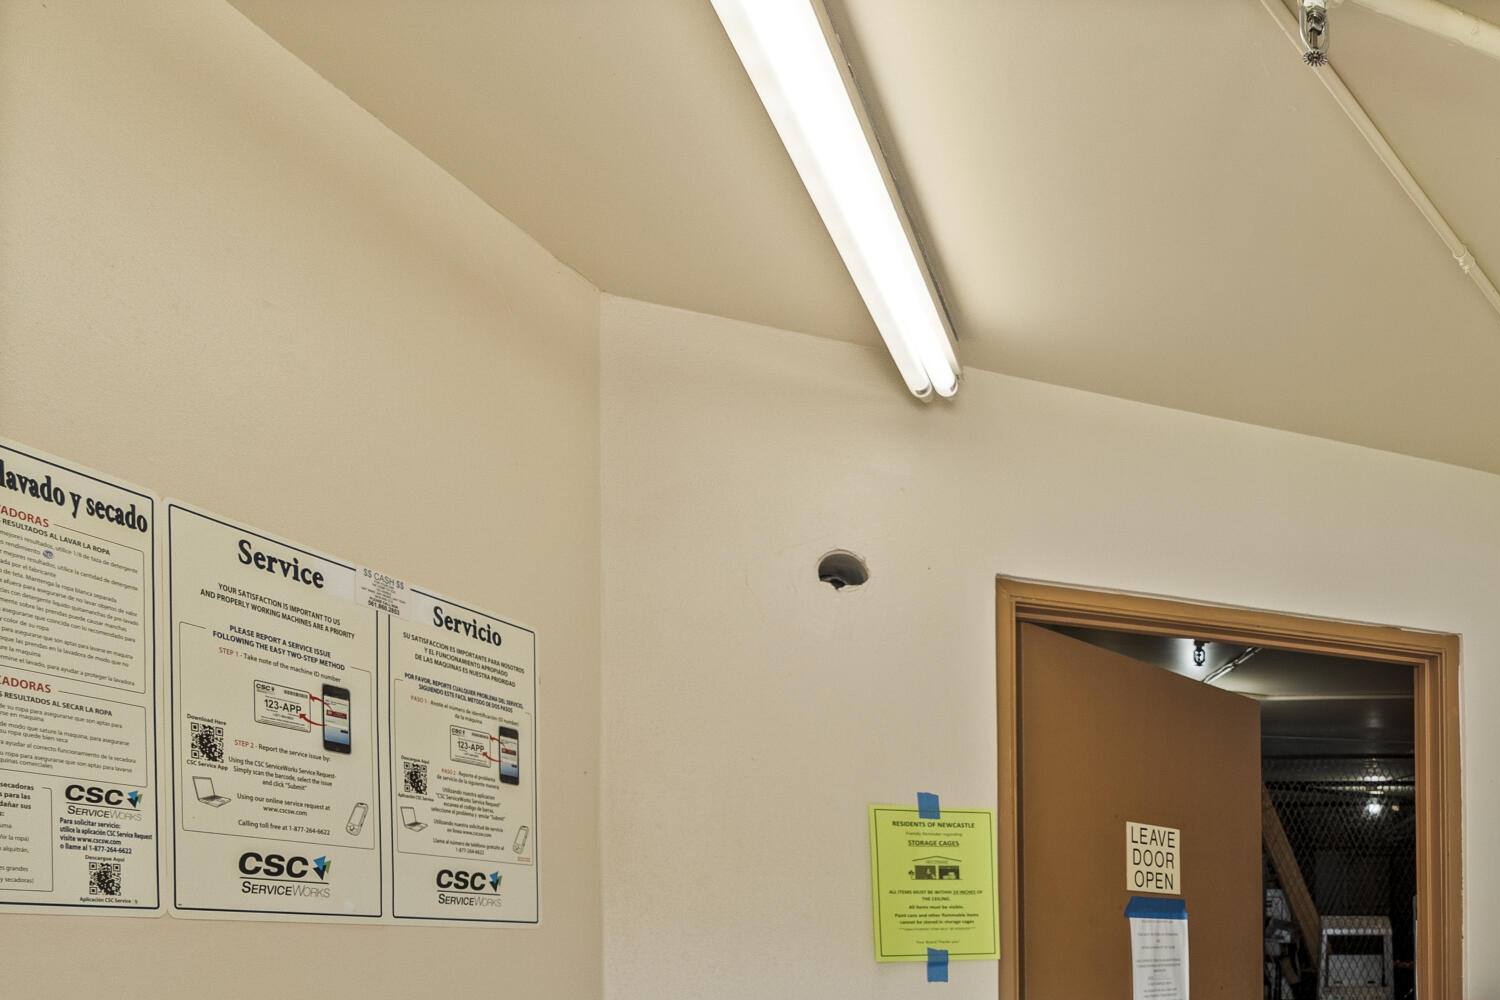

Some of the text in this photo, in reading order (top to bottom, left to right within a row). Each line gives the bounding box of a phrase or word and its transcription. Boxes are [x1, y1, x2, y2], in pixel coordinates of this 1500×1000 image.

[0, 505, 49, 527] ADORAS
[70, 492, 82, 518] y
[86, 498, 147, 532] secado
[3, 519, 48, 536] RESULTADOS
[60, 536, 81, 547] LAVAR
[83, 542, 91, 550] LA
[92, 545, 110, 555] ROPA
[238, 539, 324, 588] Service
[200, 589, 215, 599] AND
[217, 594, 250, 608] PROPERLY
[251, 604, 280, 618] WORKING
[282, 613, 312, 627] MACHINES
[313, 622, 324, 630] ARE
[330, 627, 354, 639] PRIORITY
[218, 583, 236, 594] YOUR
[238, 589, 281, 608] SATISFACTION
[289, 605, 323, 620] IMPORTANT
[324, 615, 332, 623] TO
[433, 606, 501, 646] Servicio
[0, 676, 51, 693] ADORAS
[5, 692, 50, 705] RESULTADOS
[62, 702, 84, 711] SECAR
[95, 708, 112, 716] ROPA
[264, 699, 302, 714] 123-APP
[458, 741, 484, 751] 123-APP
[65, 784, 124, 805] CSC
[1131, 826, 1175, 848] LEAVE
[239, 852, 309, 878] CSC
[1133, 848, 1174, 869] DOOR
[437, 870, 486, 891] CSC
[1135, 871, 1173, 890] OPEN
